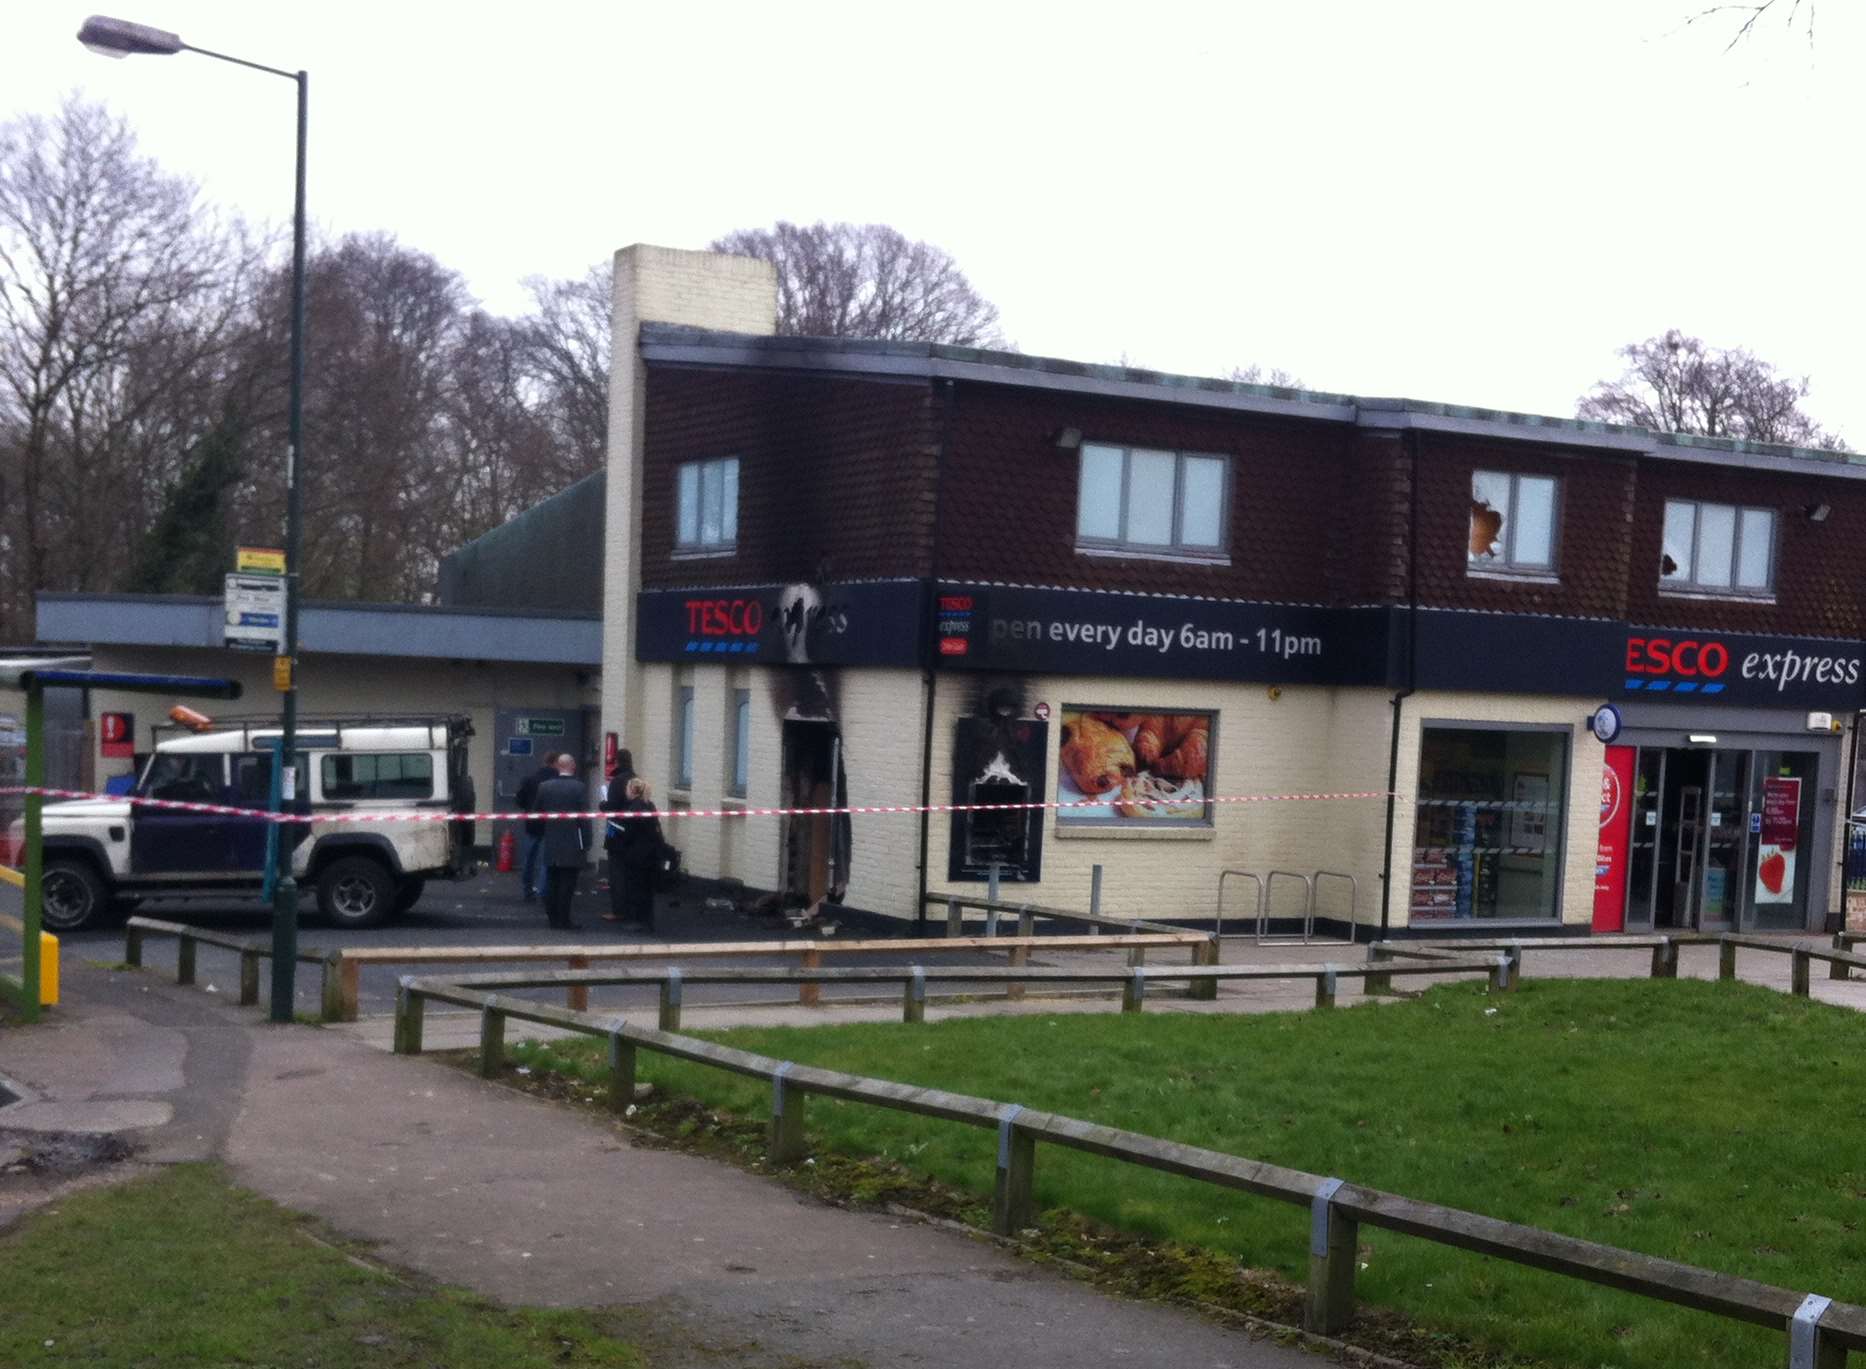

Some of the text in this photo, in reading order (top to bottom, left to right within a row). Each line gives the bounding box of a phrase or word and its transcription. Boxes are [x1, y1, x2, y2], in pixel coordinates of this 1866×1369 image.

[686, 599, 764, 635] TESCO
[1049, 621, 1122, 650] every
[1128, 620, 1175, 653] day
[1180, 623, 1233, 650] 6am
[1256, 628, 1322, 659] 11pm
[1625, 637, 1860, 691] ESCO express
